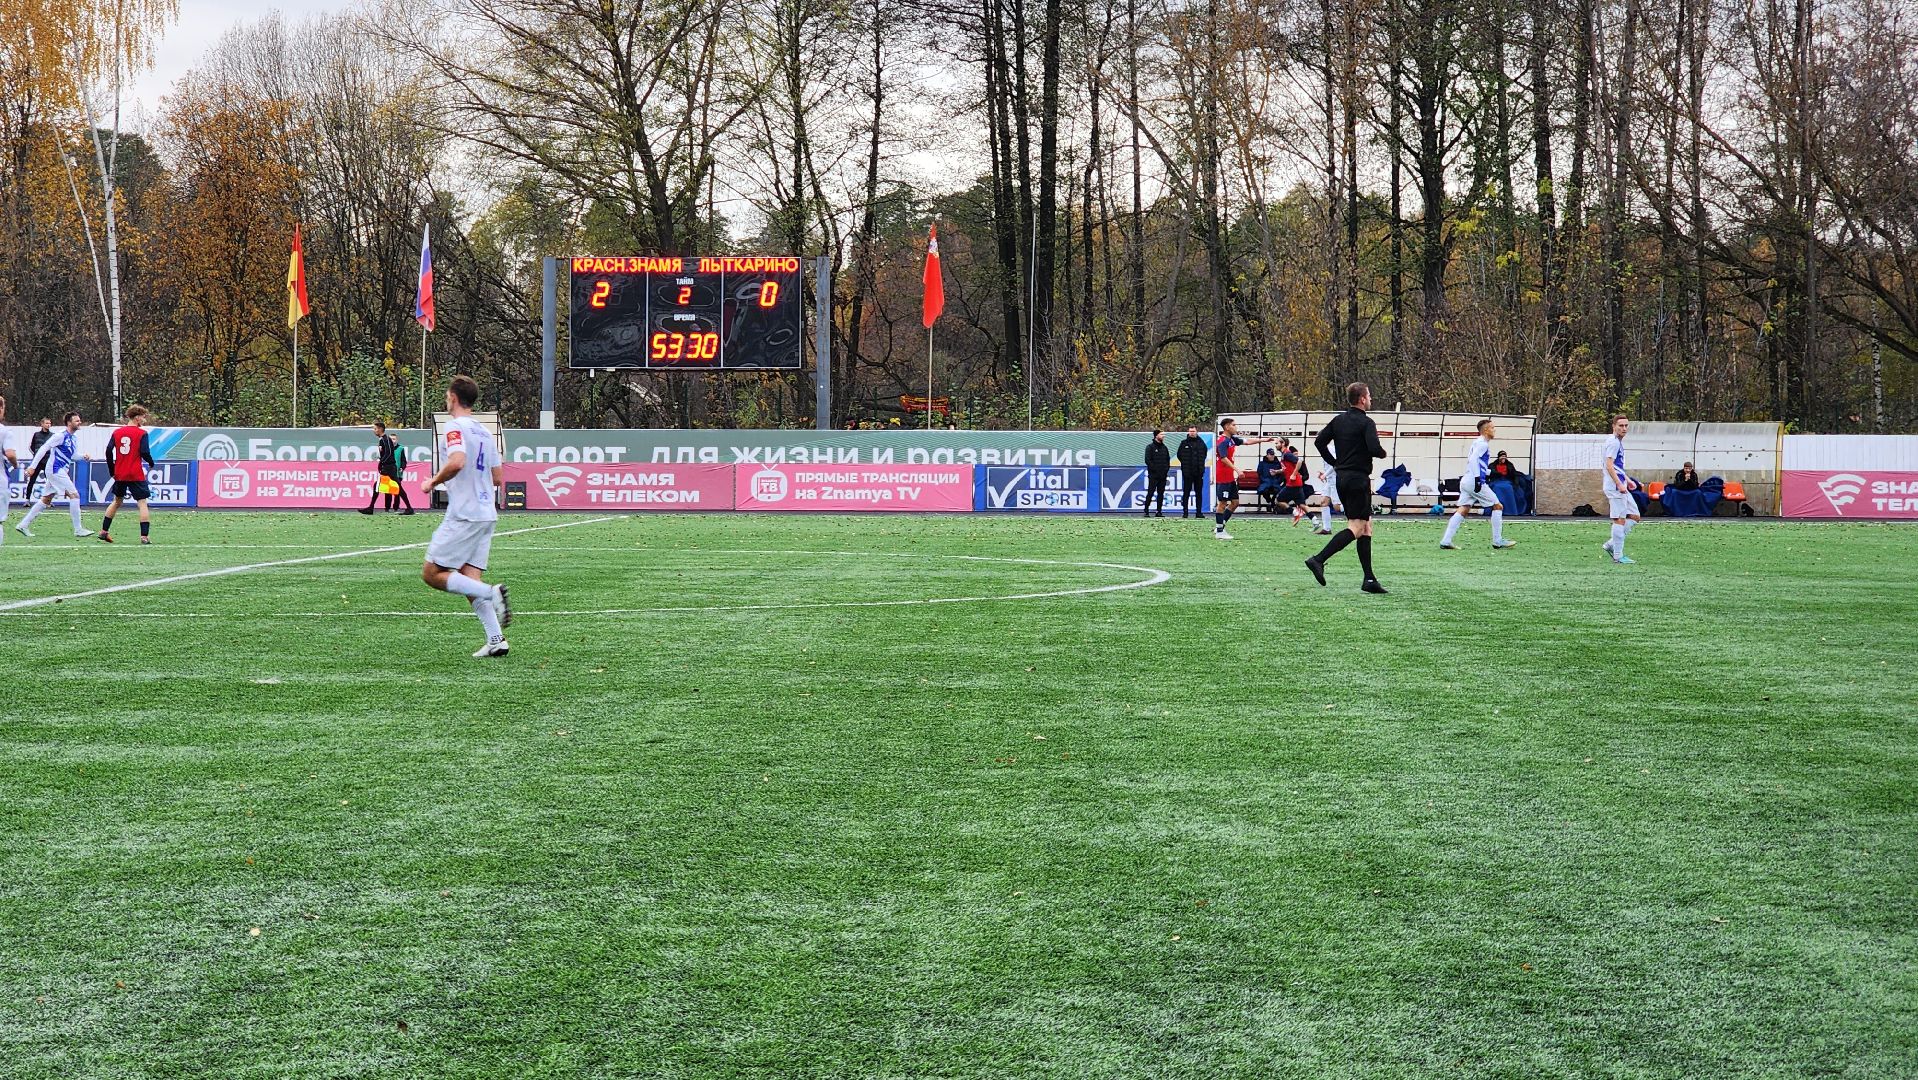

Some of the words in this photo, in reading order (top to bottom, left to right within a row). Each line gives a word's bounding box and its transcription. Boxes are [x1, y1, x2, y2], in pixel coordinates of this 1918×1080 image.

[573, 257, 683, 273] КРАСН.ЗНАМЯ
[699, 257, 799, 273] ЛЫТКАРИНО
[675, 276, 694, 285] ТАЙМ
[591, 281, 610, 307] 2
[678, 287, 691, 304] 2
[759, 281, 777, 307] 0
[119, 436, 131, 455] 3
[476, 442, 484, 472] 4
[257, 470, 319, 481] ПРЯМЫЕ
[586, 472, 675, 486] ЗНАМЯ
[795, 472, 858, 484] ПРЯМЫЕ
[861, 472, 960, 485] ТРАНСЛЯЦИИ
[223, 481, 240, 490] ТВ
[256, 486, 279, 497] на
[282, 484, 352, 501] Znamya
[760, 483, 778, 493] ТВ
[586, 489, 700, 503] ТЕЛЕКОМ
[794, 488, 817, 500] на
[821, 487, 893, 503] Znamya
[896, 487, 922, 500] TV
